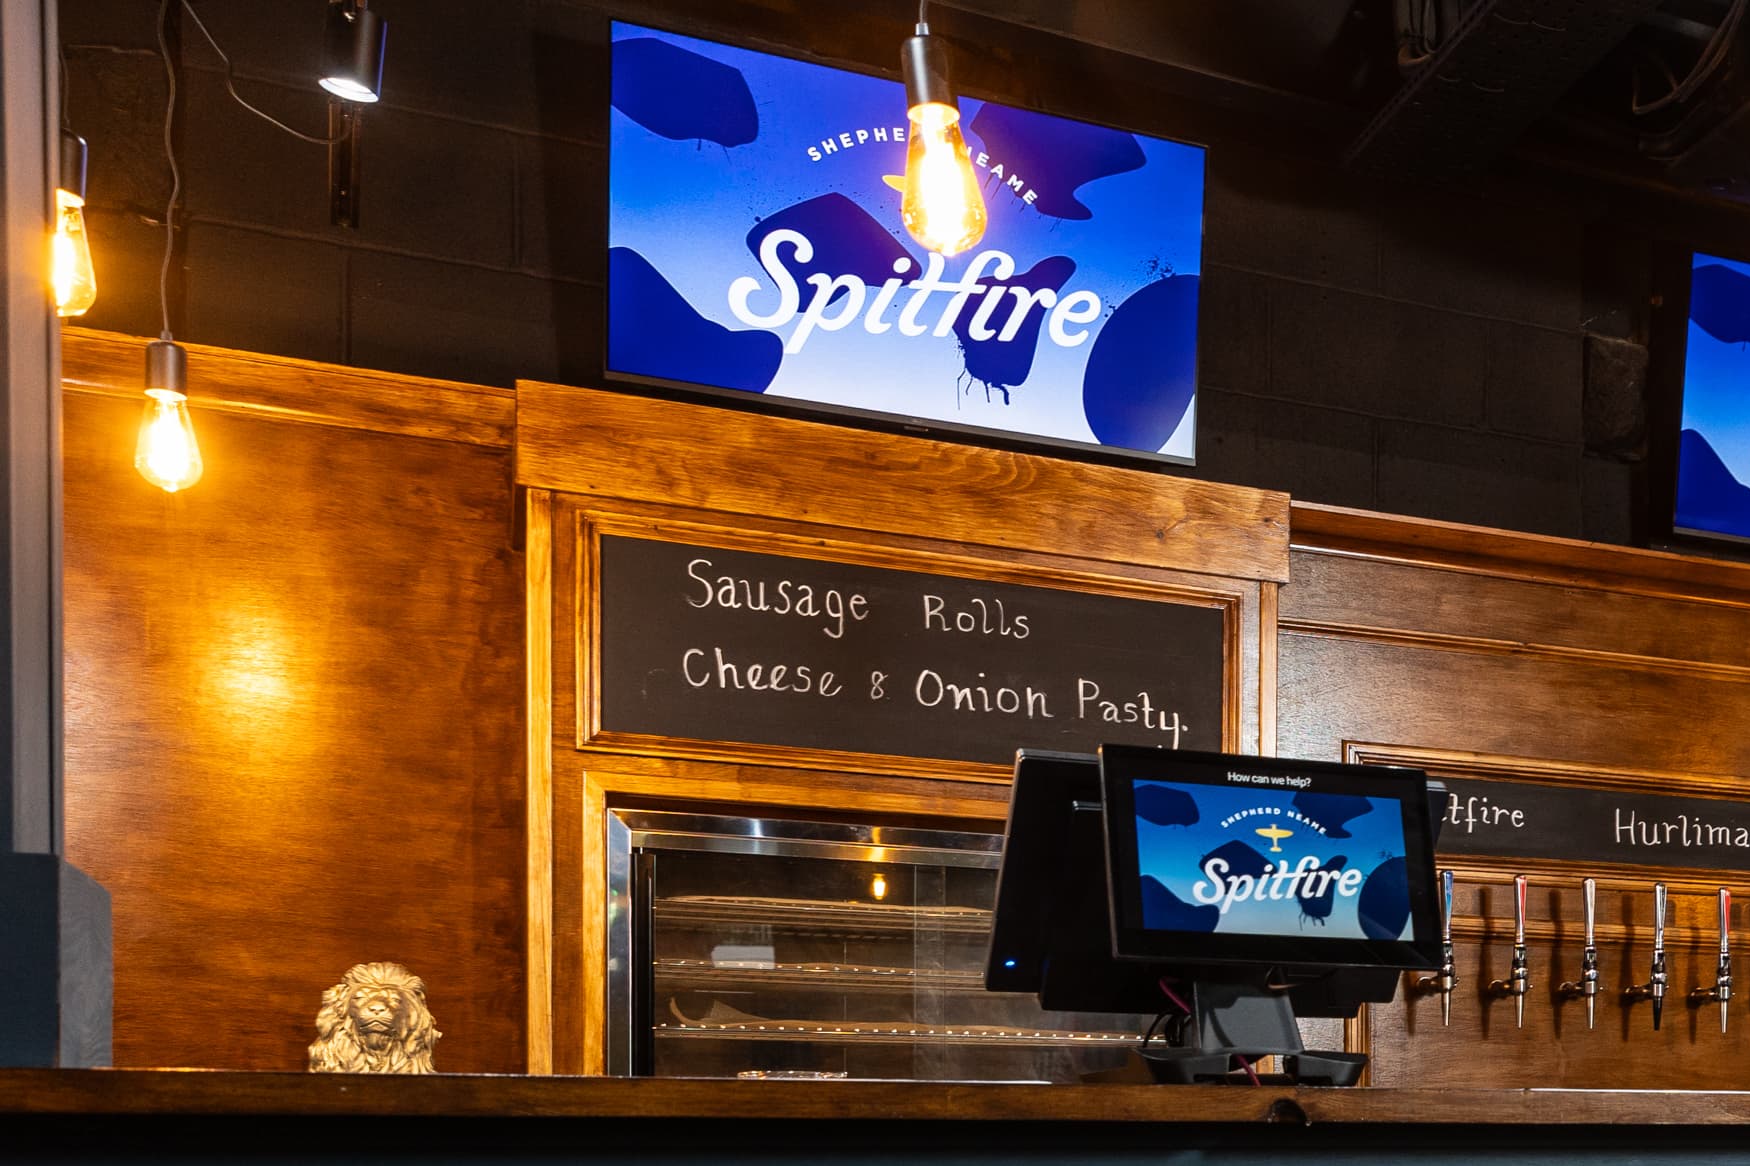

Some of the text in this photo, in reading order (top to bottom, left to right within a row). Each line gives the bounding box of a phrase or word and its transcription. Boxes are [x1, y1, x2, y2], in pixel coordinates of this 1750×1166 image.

[808, 127, 906, 162] SHEPHE
[728, 229, 1101, 354] Spitfire
[686, 558, 1030, 639] Sausage Rolls
[683, 647, 843, 698] Cheese
[915, 669, 1054, 720] Onion
[1227, 771, 1312, 789] How can we help?
[1220, 807, 1327, 835] SHEPHERD NEAME
[1441, 793, 1525, 833] tfire
[1192, 855, 1362, 914] Spitfire
